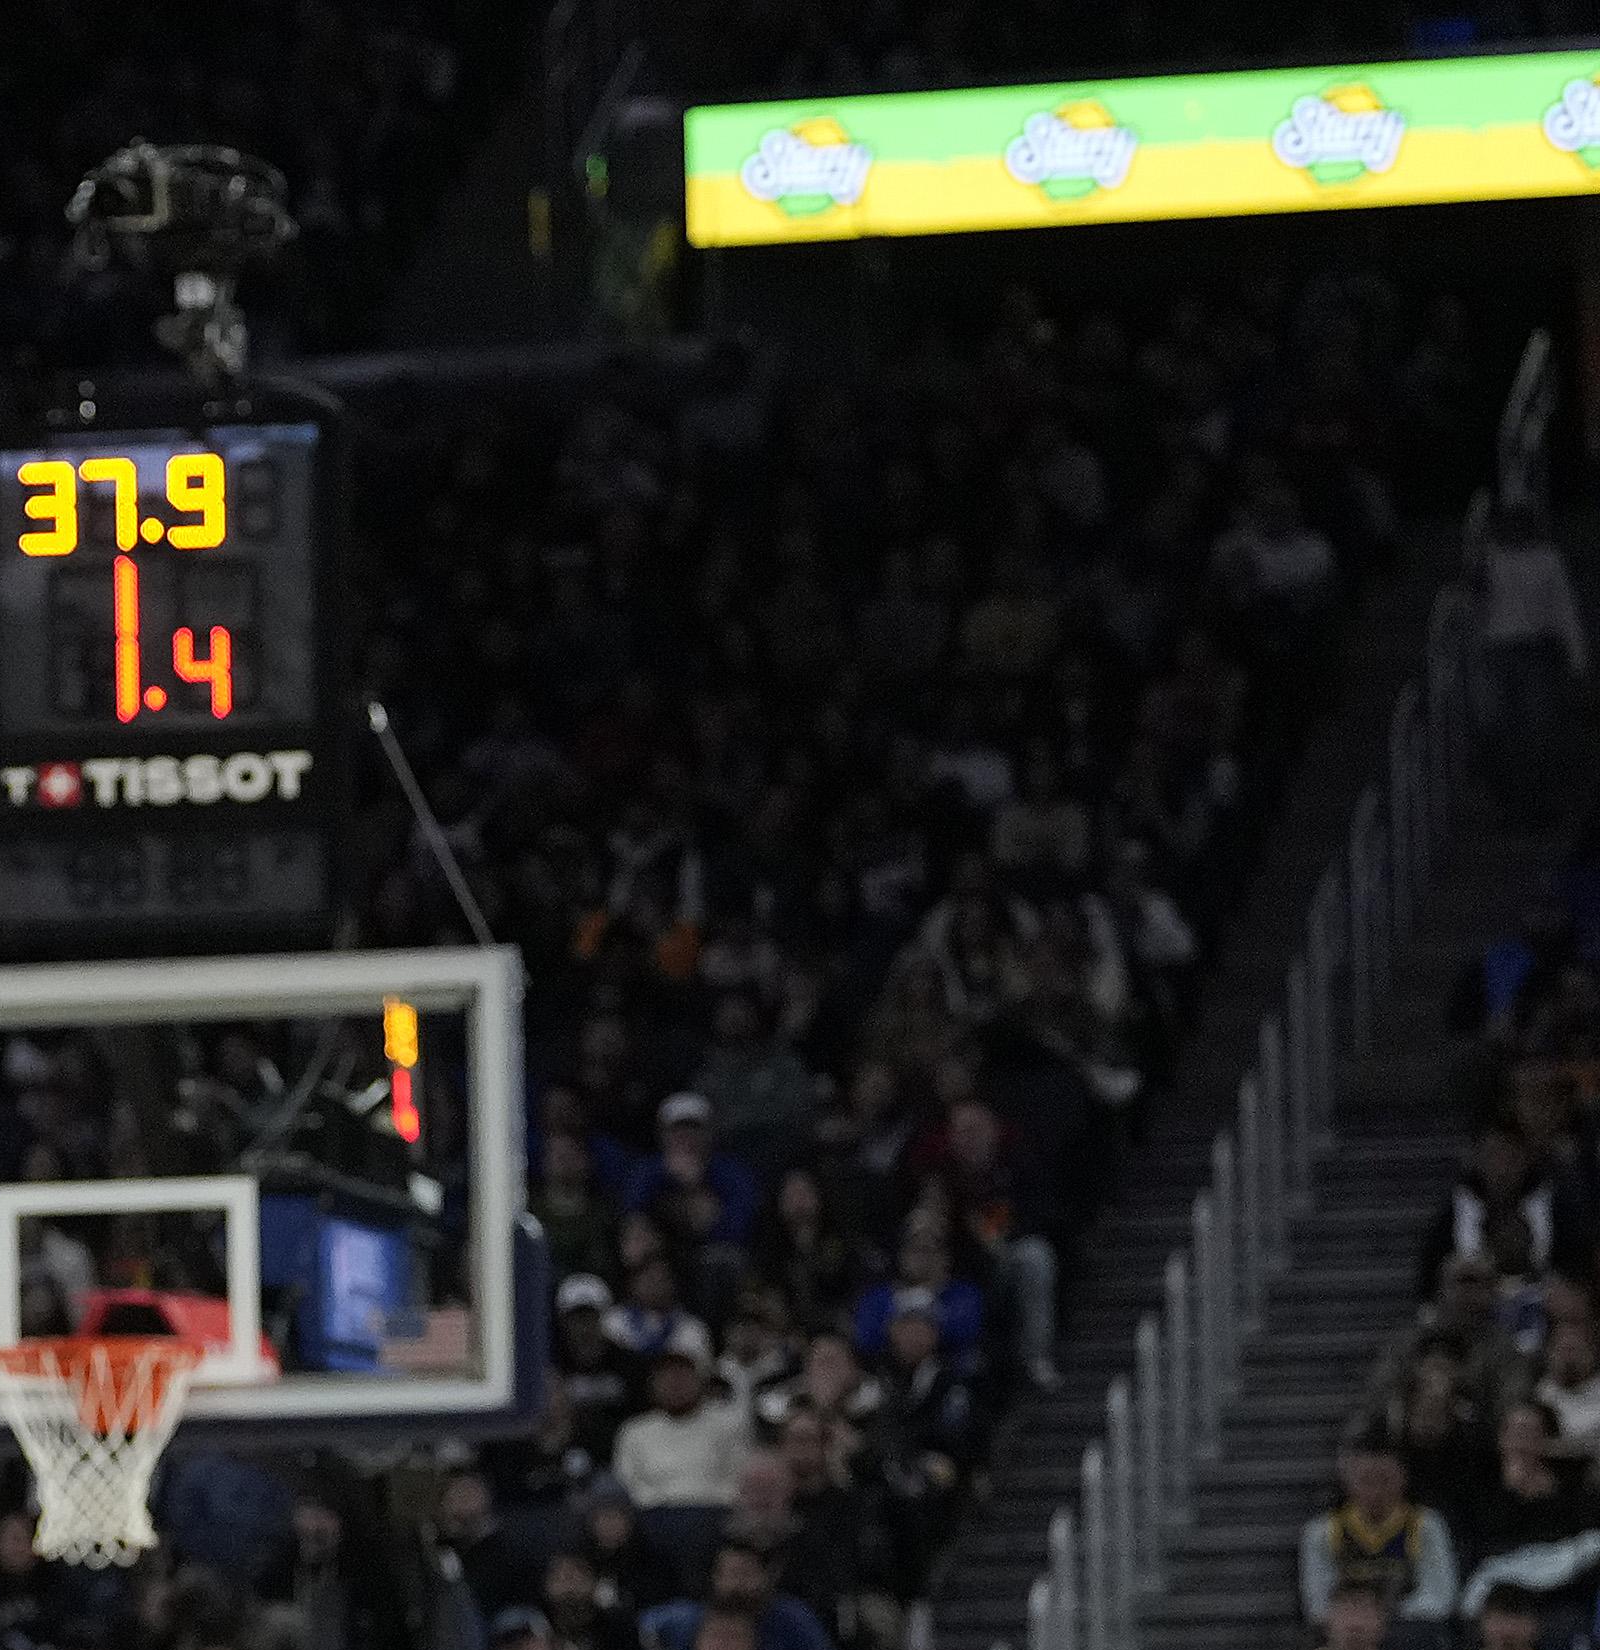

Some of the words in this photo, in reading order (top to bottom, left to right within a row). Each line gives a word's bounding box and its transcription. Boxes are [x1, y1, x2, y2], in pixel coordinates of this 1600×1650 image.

[17, 452, 226, 557] 37.9
[113, 554, 233, 724] 1.4
[84, 750, 313, 808] TISSOT
